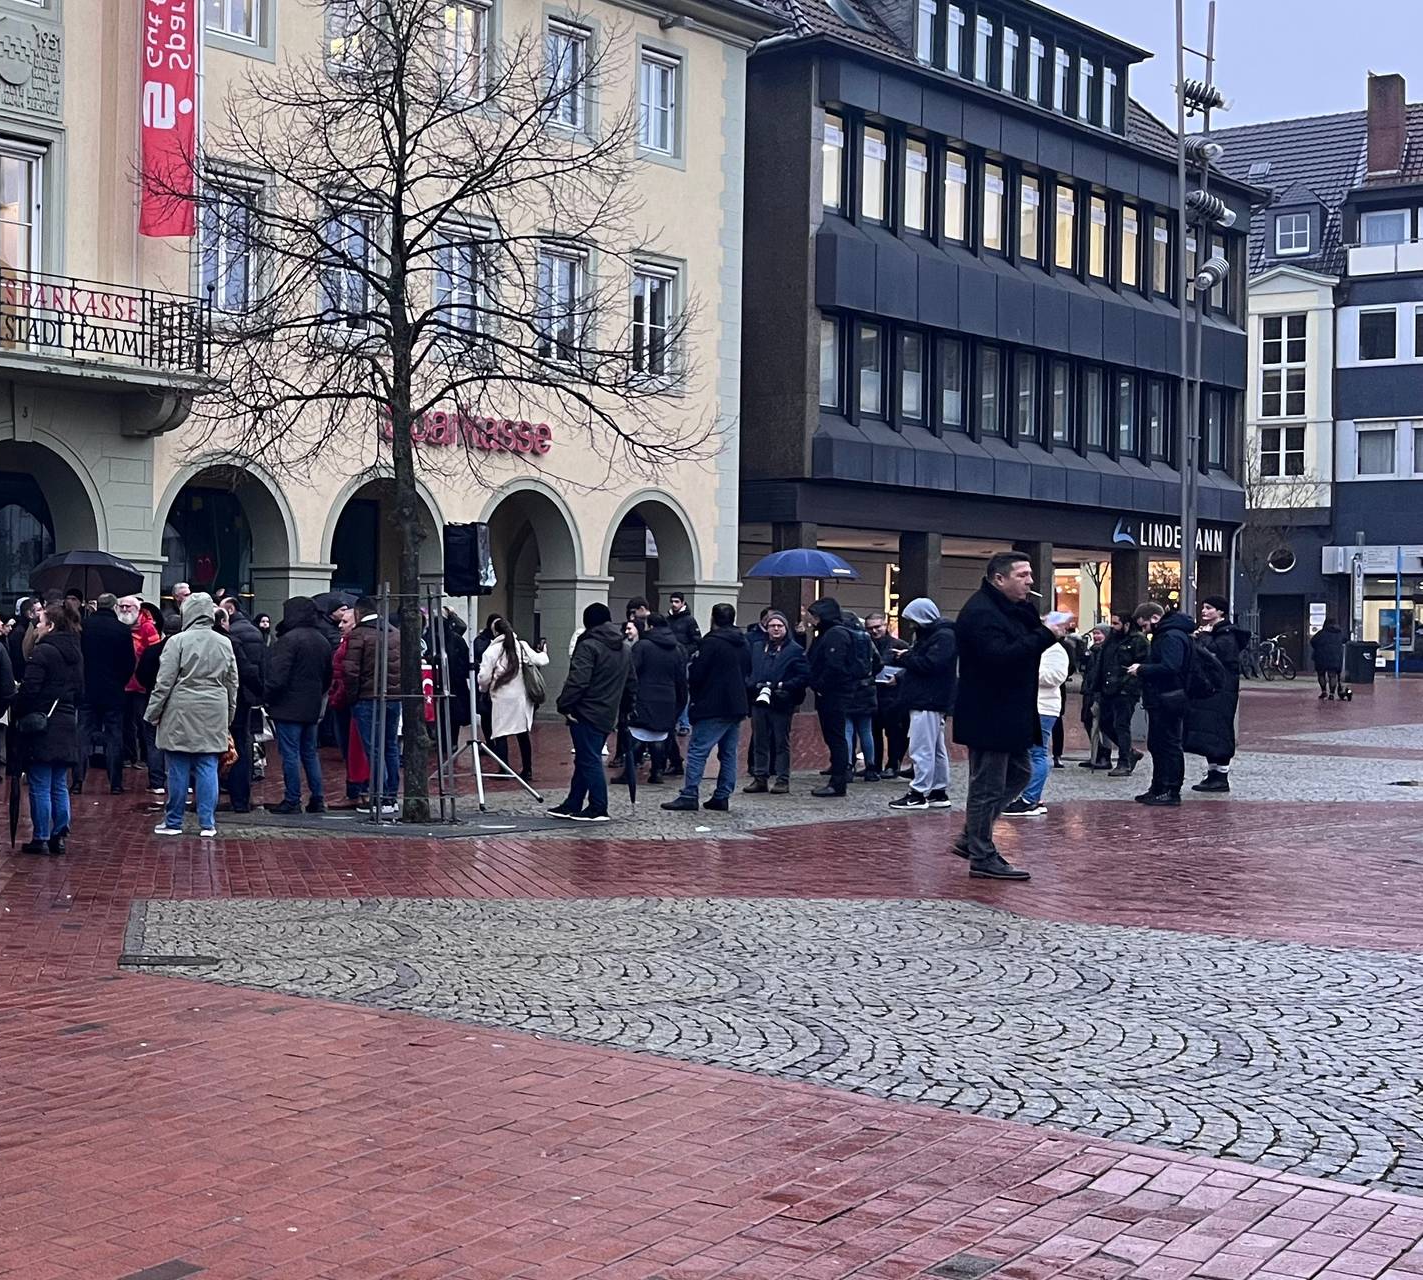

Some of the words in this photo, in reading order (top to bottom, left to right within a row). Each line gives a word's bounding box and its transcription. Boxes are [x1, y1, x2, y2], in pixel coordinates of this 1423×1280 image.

[36, 32, 61, 53] 1951
[4, 279, 138, 324] SPARKASSE
[5, 315, 65, 348] STADT
[72, 322, 138, 357] HAMM
[1140, 522, 1223, 553] LINDEANN
